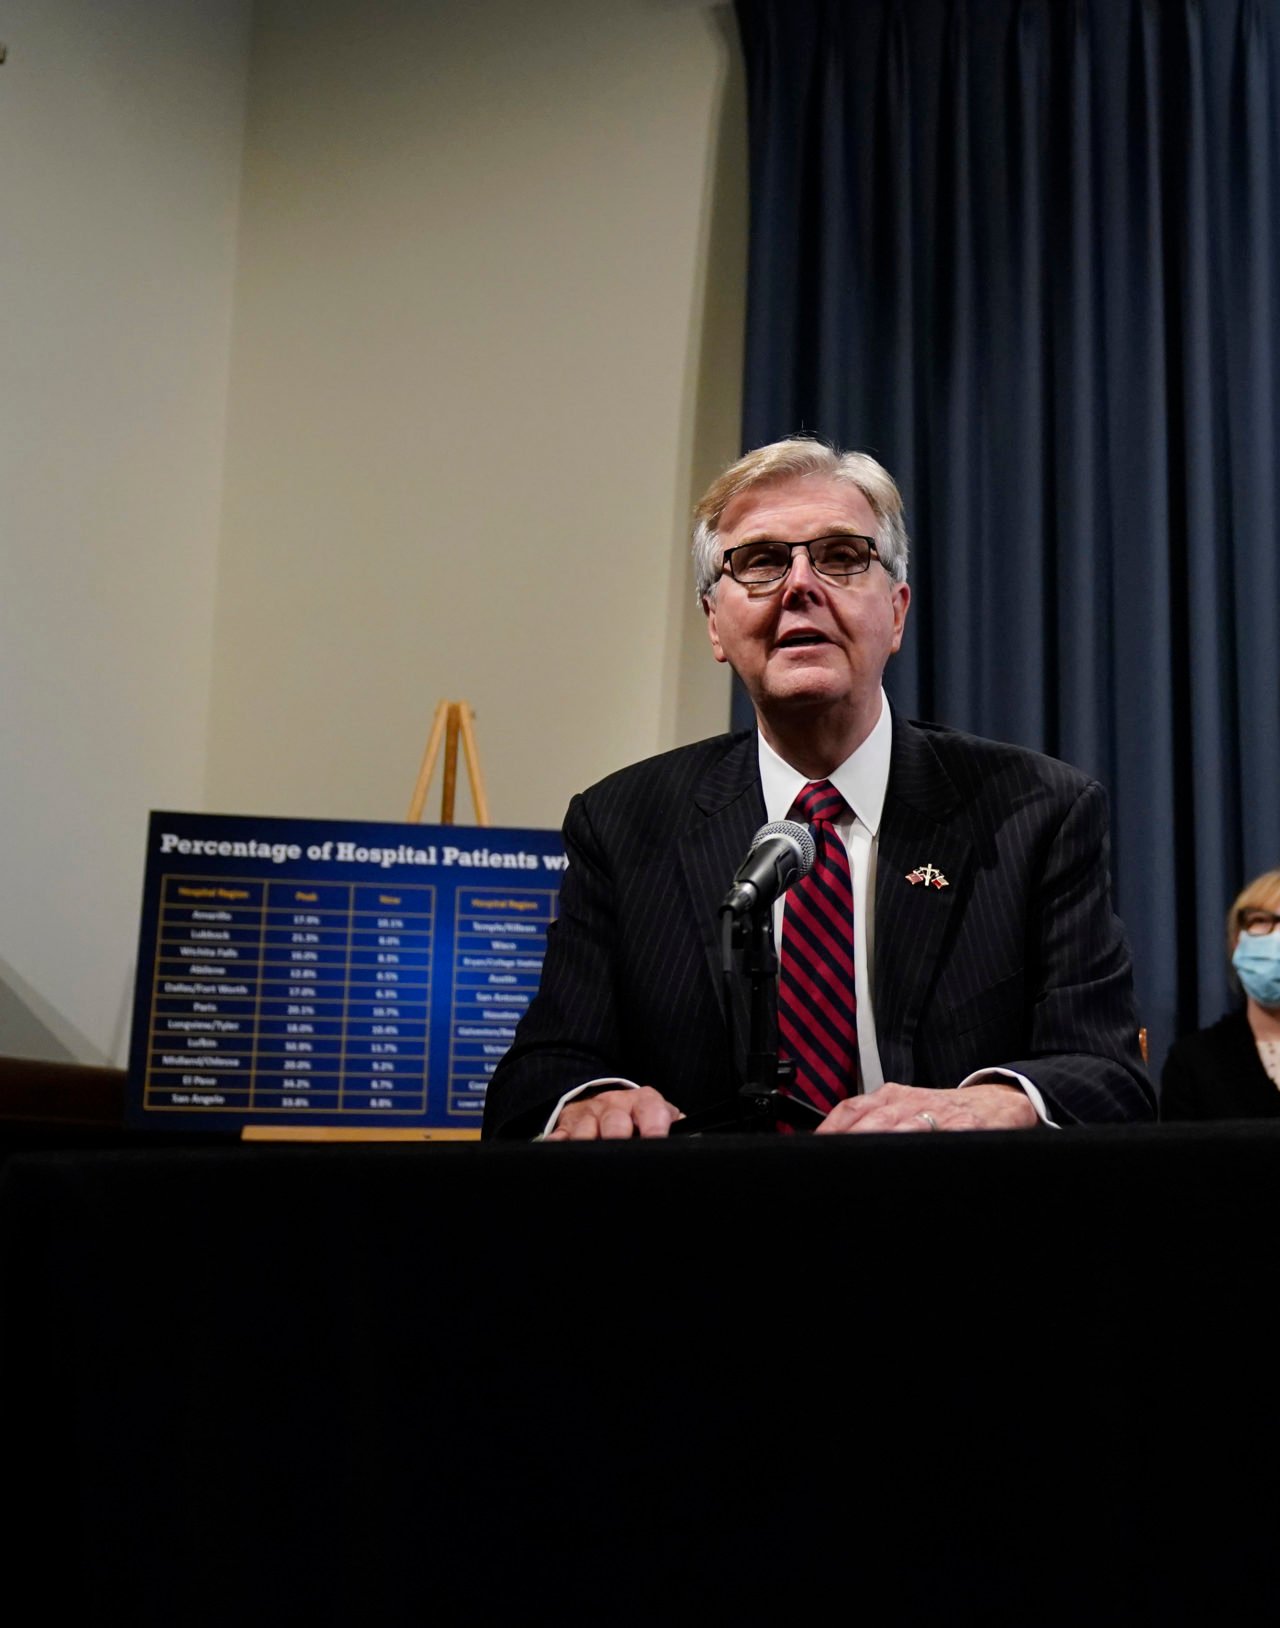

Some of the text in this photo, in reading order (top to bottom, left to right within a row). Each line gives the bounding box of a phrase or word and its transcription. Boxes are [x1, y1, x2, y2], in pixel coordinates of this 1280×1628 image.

[160, 833, 570, 871] Percentage of Hospital Patients wi
